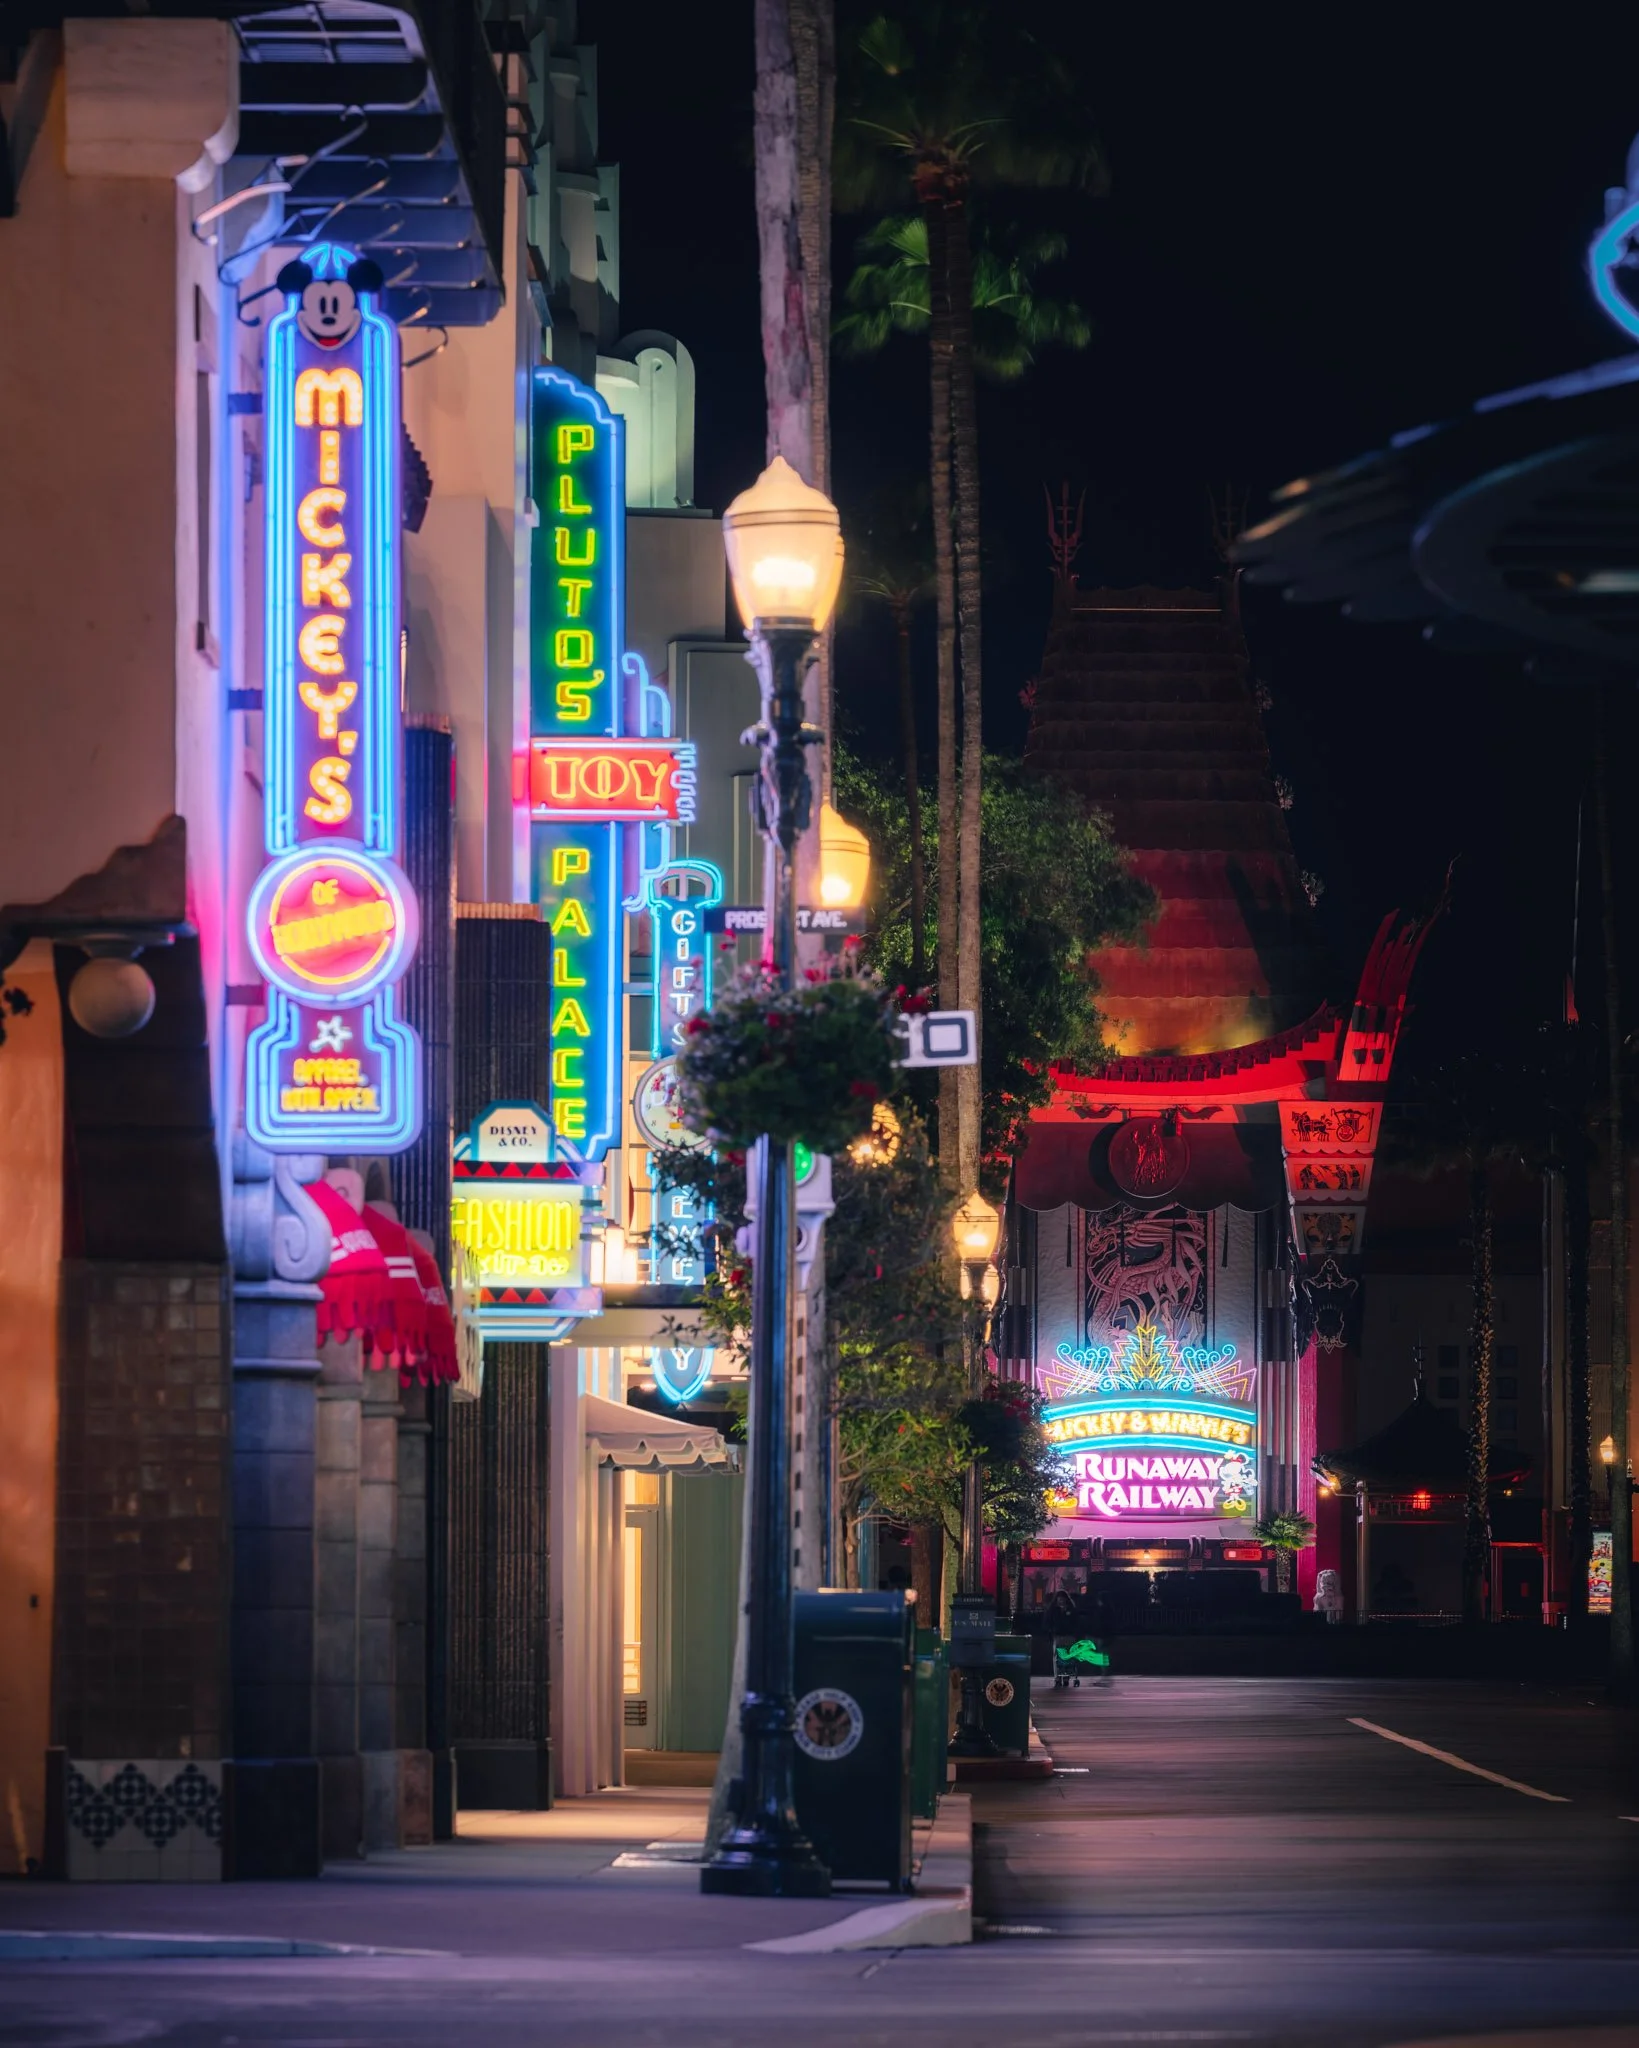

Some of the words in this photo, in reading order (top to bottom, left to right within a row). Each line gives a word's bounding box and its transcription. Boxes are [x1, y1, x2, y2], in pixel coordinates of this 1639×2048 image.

[554, 424, 605, 721] PLUTO'S
[294, 367, 363, 824] MICKEY'S
[543, 755, 669, 801] TOY
[811, 910, 848, 928] AVE.
[550, 847, 593, 1139] PALACE
[670, 909, 699, 1047] GIFTS
[489, 1126, 538, 1136] DISNEY
[498, 1137, 508, 1147] &
[510, 1137, 533, 1147] CO.
[1075, 1453, 1224, 1481] RUNAWAY
[1078, 1482, 1221, 1517] RAILWAY
